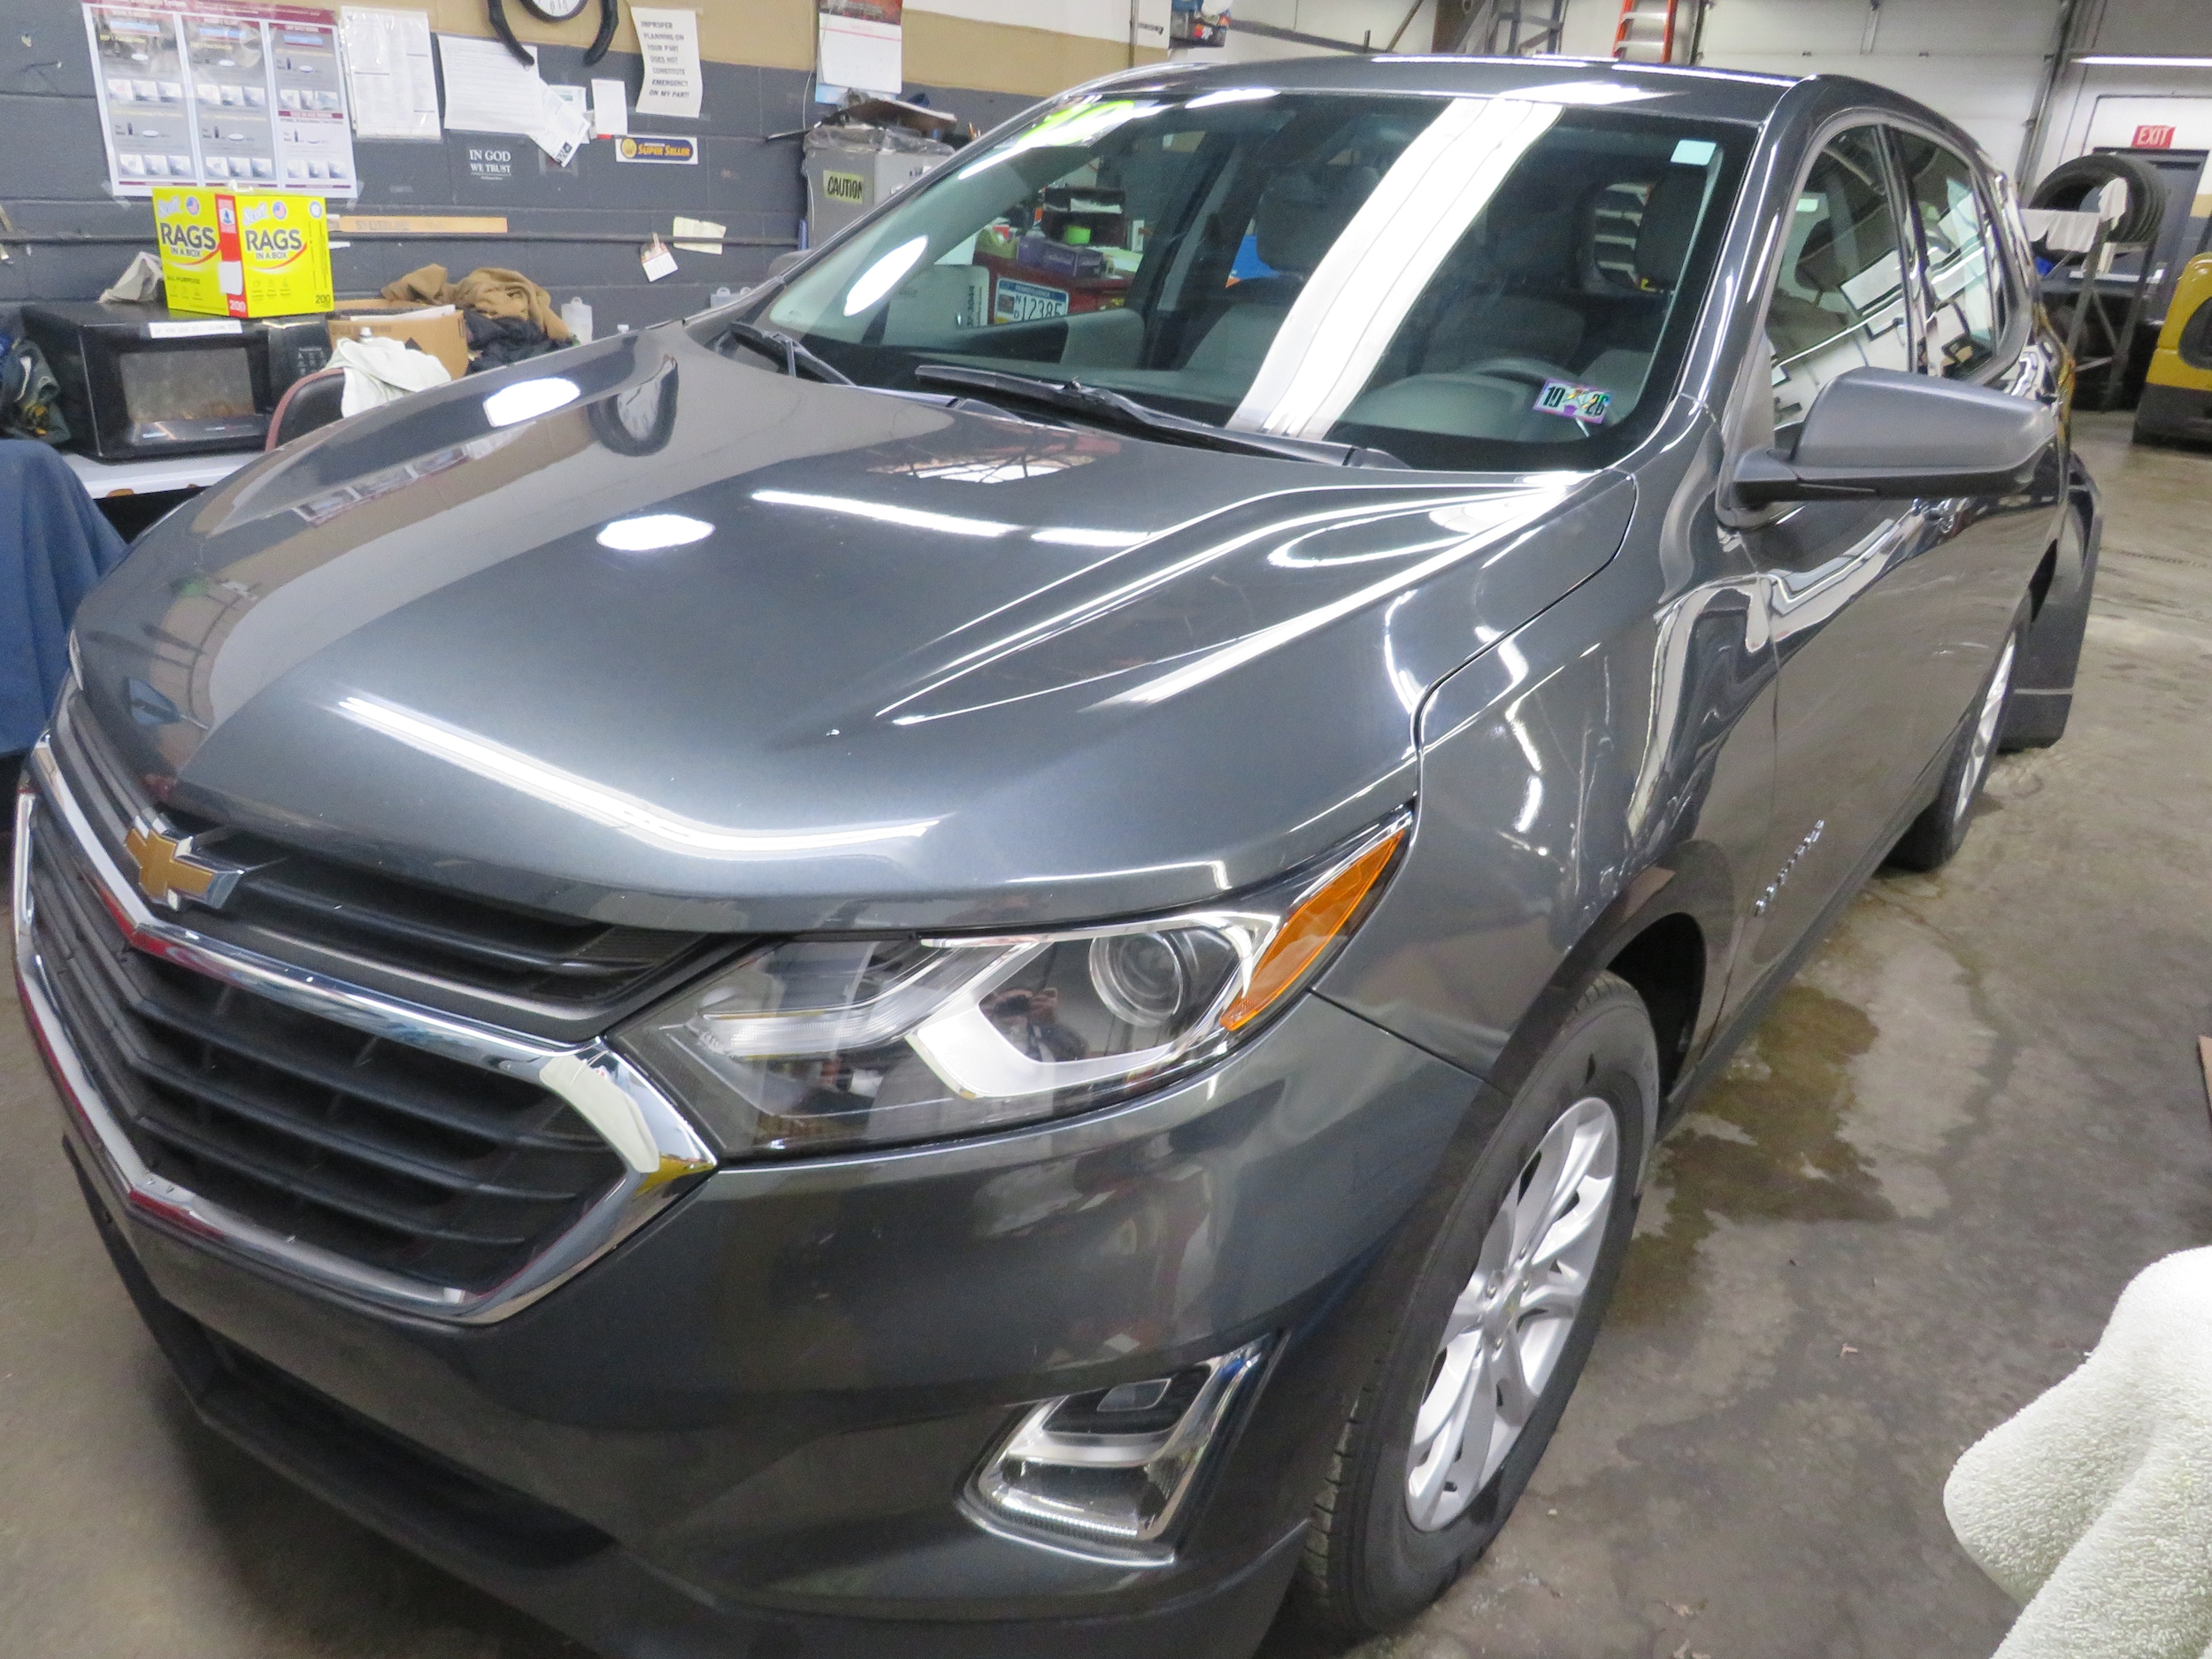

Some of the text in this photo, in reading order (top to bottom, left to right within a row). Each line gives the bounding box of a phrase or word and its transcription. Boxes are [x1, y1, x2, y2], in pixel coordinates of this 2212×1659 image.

[641, 20, 673, 29] IMPROPER
[652, 67, 686, 76] CONSTITUTE
[2136, 127, 2170, 146] EXIT
[469, 149, 511, 162] IN GOD
[470, 163, 511, 173] WE TRUST
[827, 176, 863, 199] CAUTION
[160, 222, 217, 251] RAGS
[244, 228, 303, 251] RAGS
[230, 299, 247, 312] 200
[316, 294, 332, 304] 200
